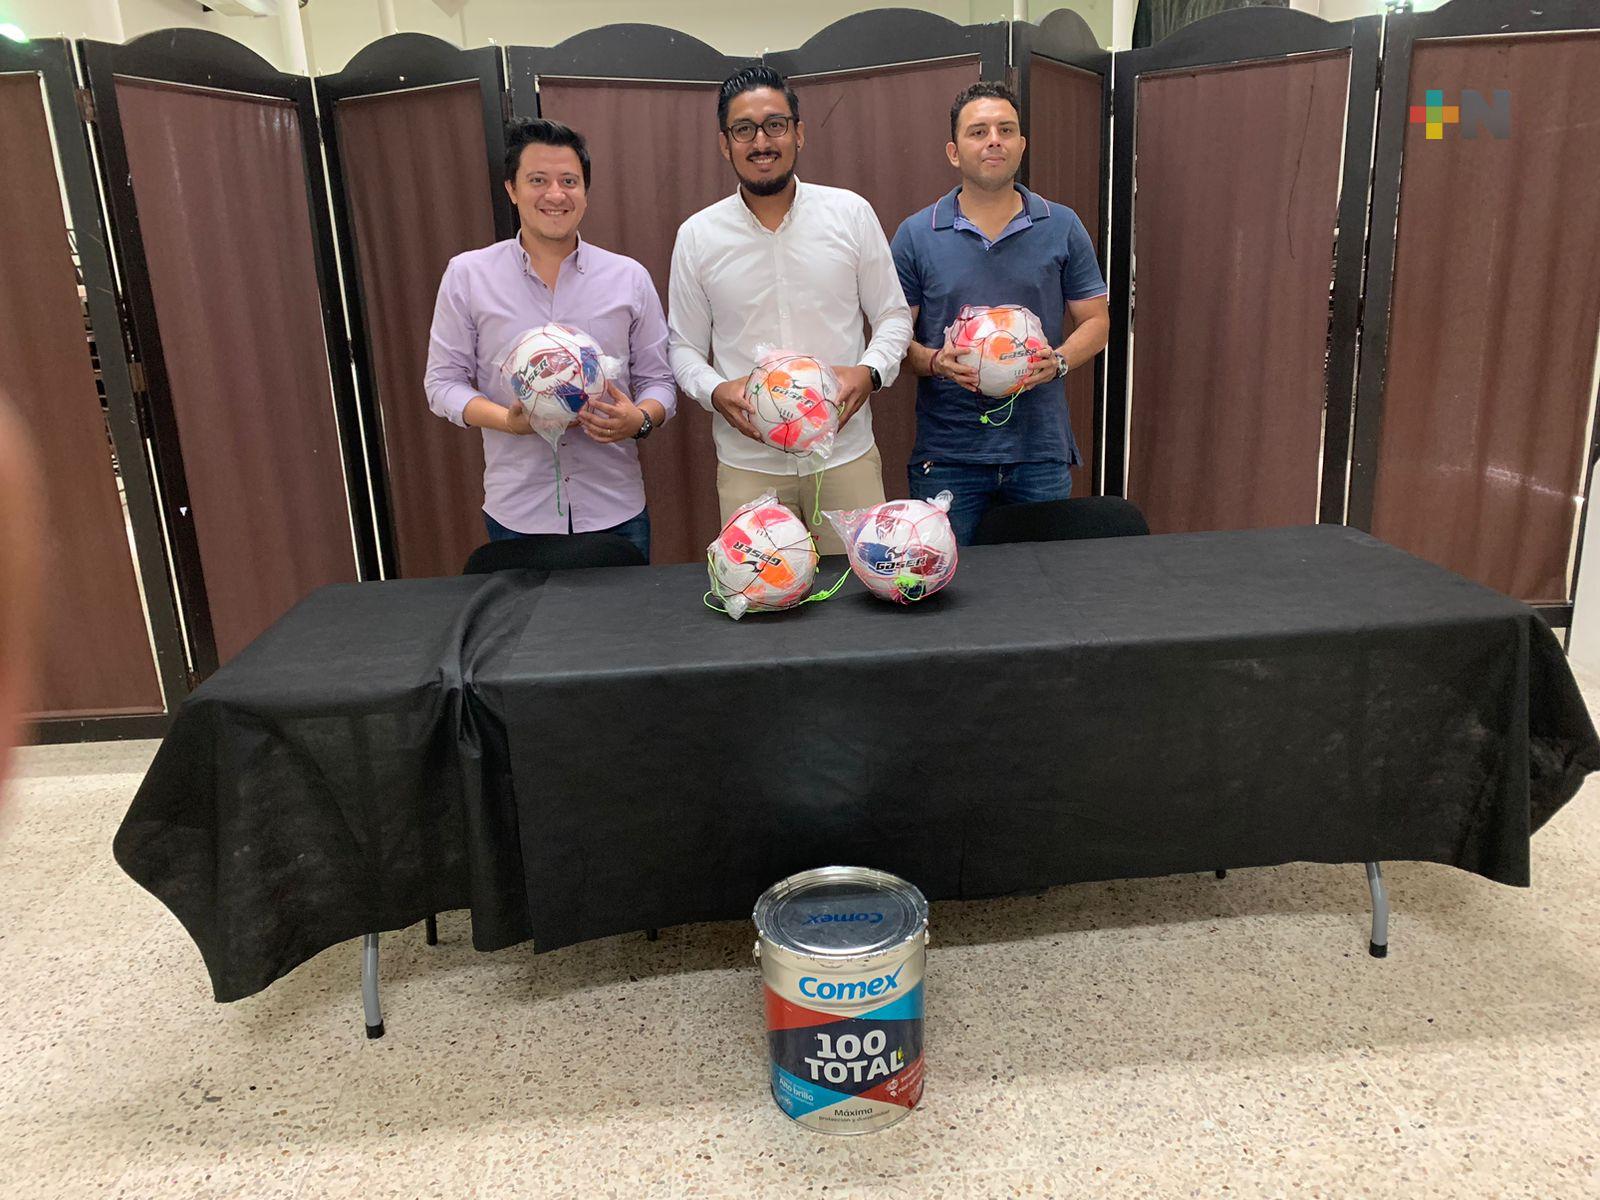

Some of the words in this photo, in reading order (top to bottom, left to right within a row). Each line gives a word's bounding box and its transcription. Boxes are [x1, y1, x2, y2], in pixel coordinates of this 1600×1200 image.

[802, 911, 884, 926] Comex
[798, 963, 904, 1000] Comex
[816, 1029, 887, 1060] 100
[804, 1050, 905, 1083] TOTAL
[834, 1107, 873, 1117] Máxima
